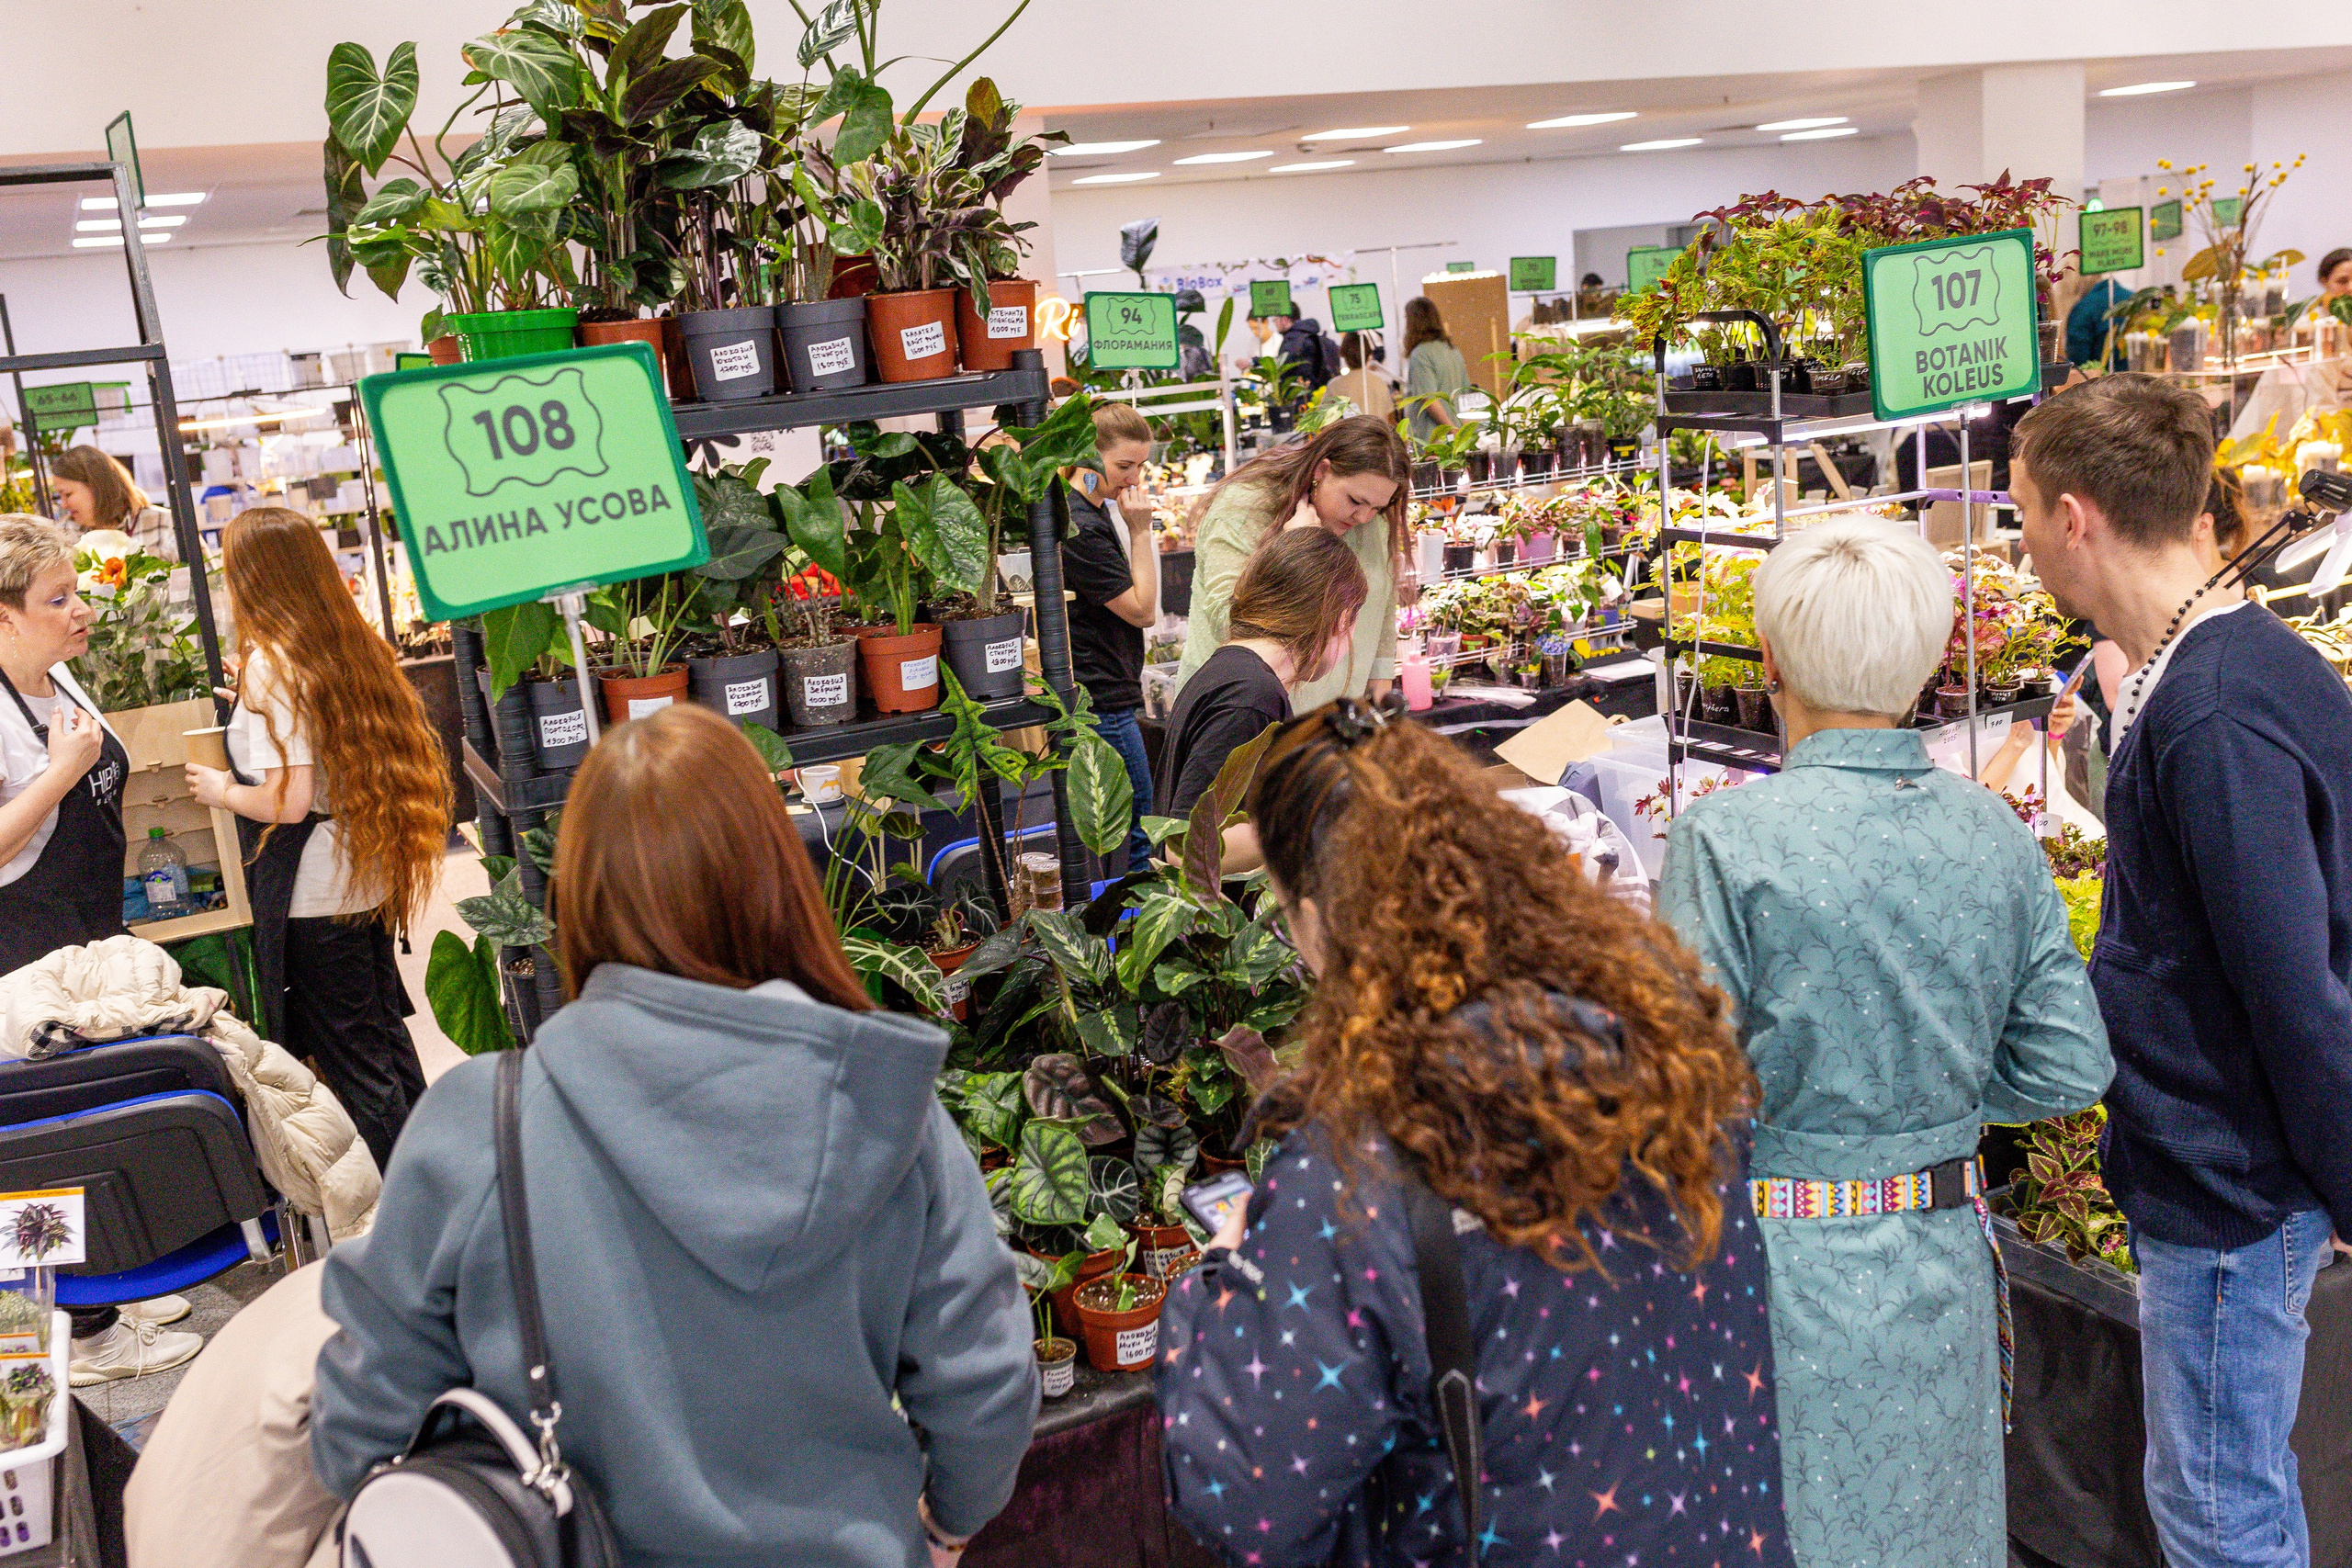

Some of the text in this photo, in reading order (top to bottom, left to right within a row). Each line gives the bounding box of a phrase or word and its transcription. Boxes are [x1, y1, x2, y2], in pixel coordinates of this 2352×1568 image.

[1177, 276, 1222, 291] BioBox
[1931, 268, 1982, 311] 107
[1121, 307, 1143, 324] 94
[991, 325, 1009, 333] 1000
[1093, 339, 1173, 351] ФЛОРАМАНИЯ
[1916, 336, 2008, 374] BOTANIK
[1923, 363, 2004, 399] KOLEUS
[472, 400, 576, 461] 108
[424, 483, 673, 556] АЛИНА УСОВА
[1125, 1349, 1144, 1359] 1600
